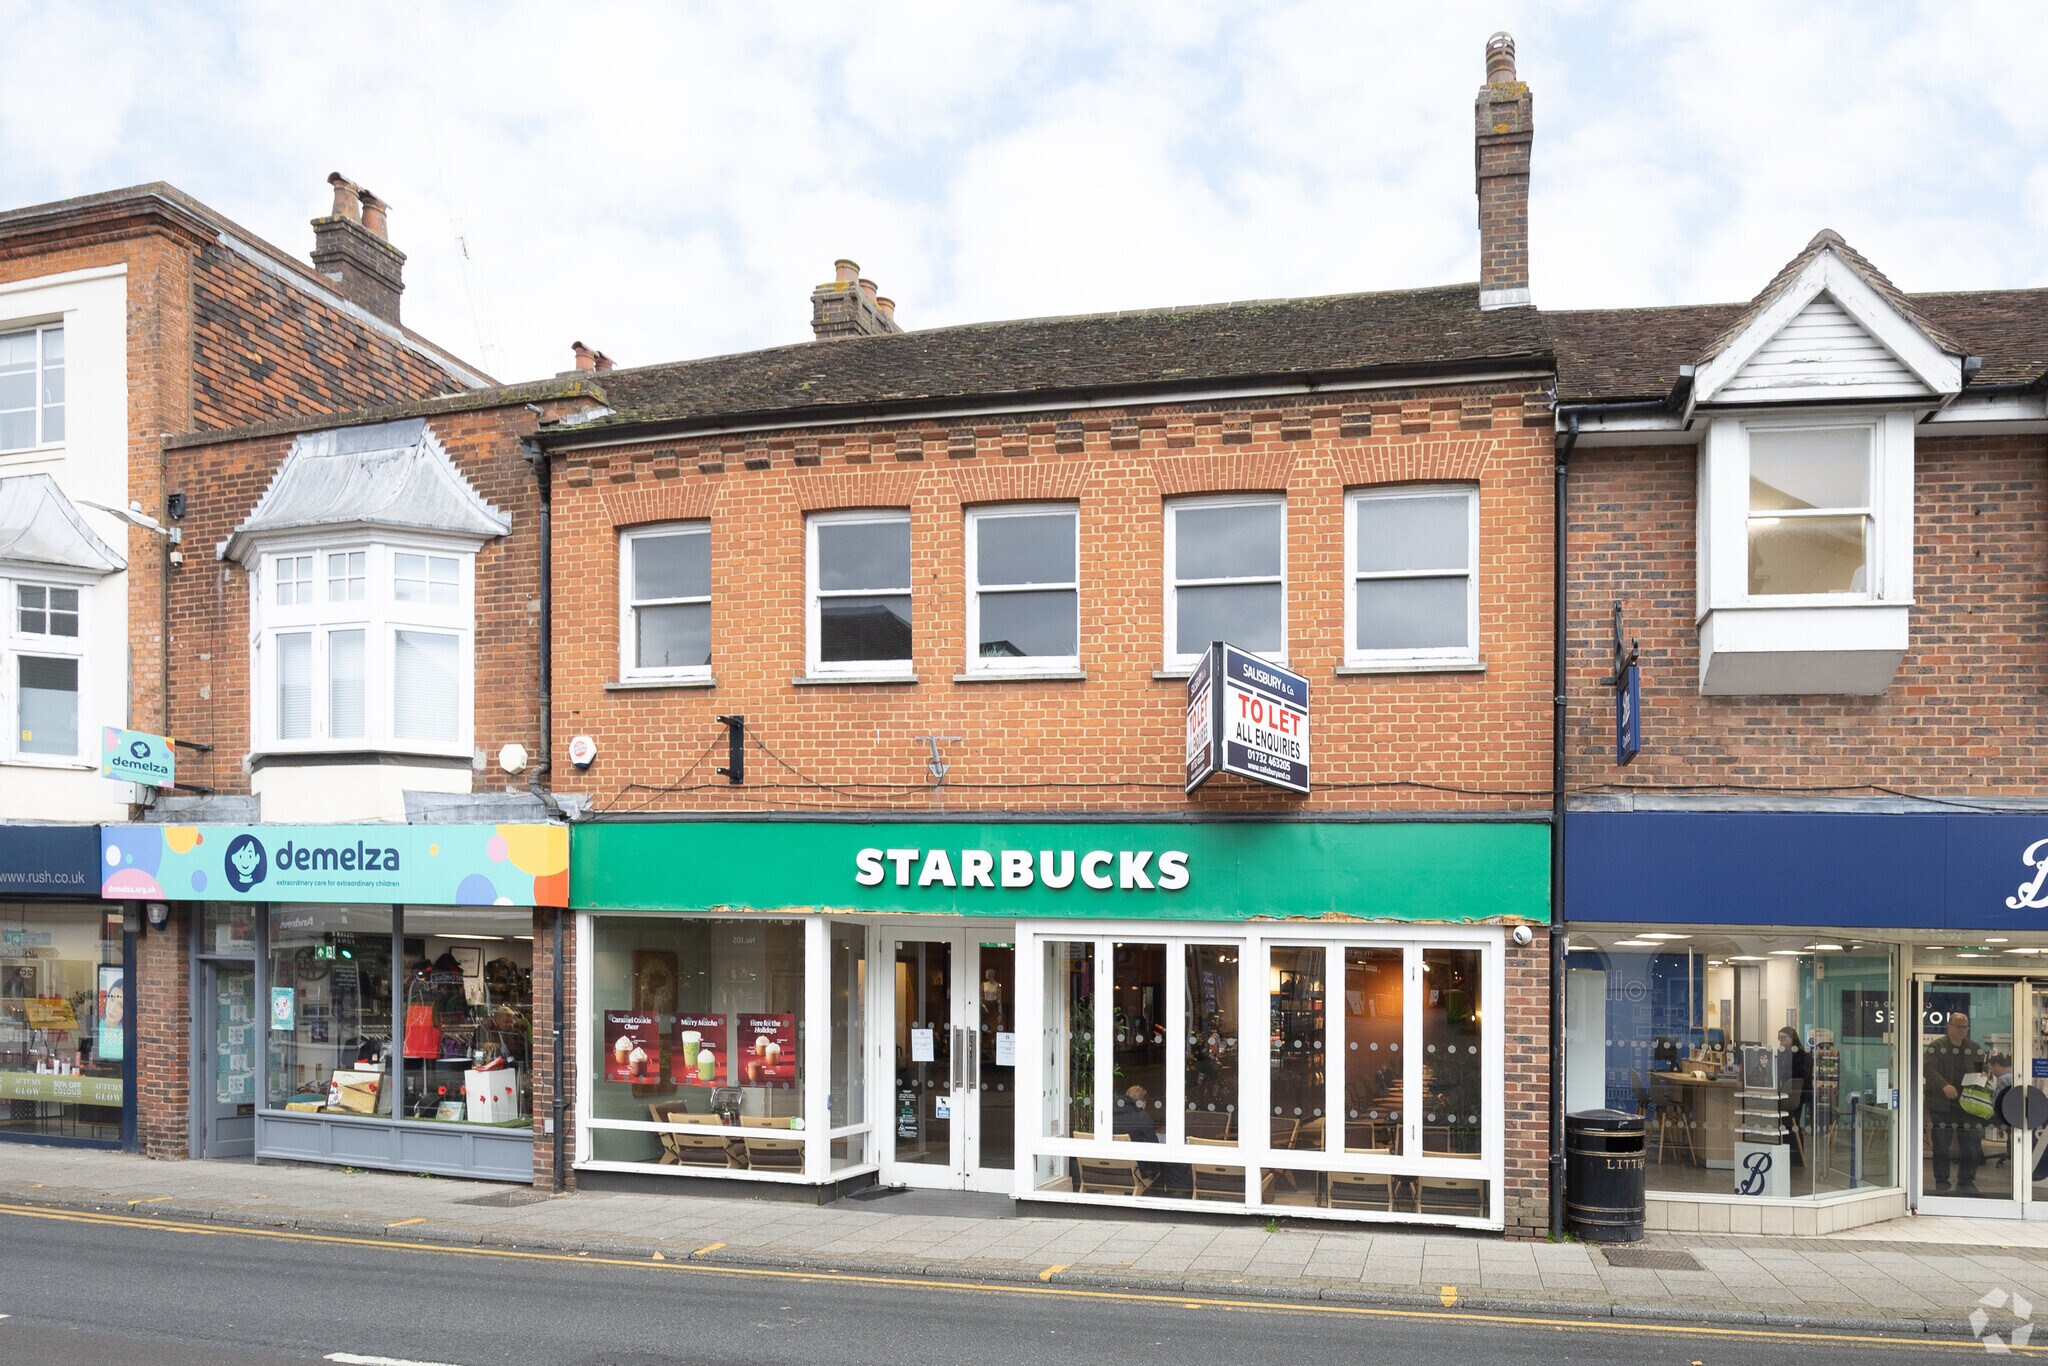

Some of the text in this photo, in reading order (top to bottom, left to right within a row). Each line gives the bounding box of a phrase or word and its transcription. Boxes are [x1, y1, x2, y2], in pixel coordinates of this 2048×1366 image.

[1243, 663, 1281, 690] SALISBURY
[1281, 683, 1286, 692] &
[1238, 693, 1300, 736] TO LET
[1236, 722, 1300, 760] ALL ENQUIRIES
[112, 756, 168, 774] demelza
[1247, 749, 1290, 771] 01732 463205
[1247, 762, 1290, 780] www.salisburyand.co
[275, 840, 400, 871] demelza
[0, 870, 85, 884] www.rush.co.uk
[855, 848, 1190, 890] STARBUCKS
[108, 884, 156, 894] demelza.org.uk
[336, 880, 374, 888] extraordinary
[1860, 1000, 1879, 1008] IT'S
[68, 1081, 82, 1089] OFF
[96, 1093, 121, 1101] GLOW
[1734, 1152, 1772, 1196] B
